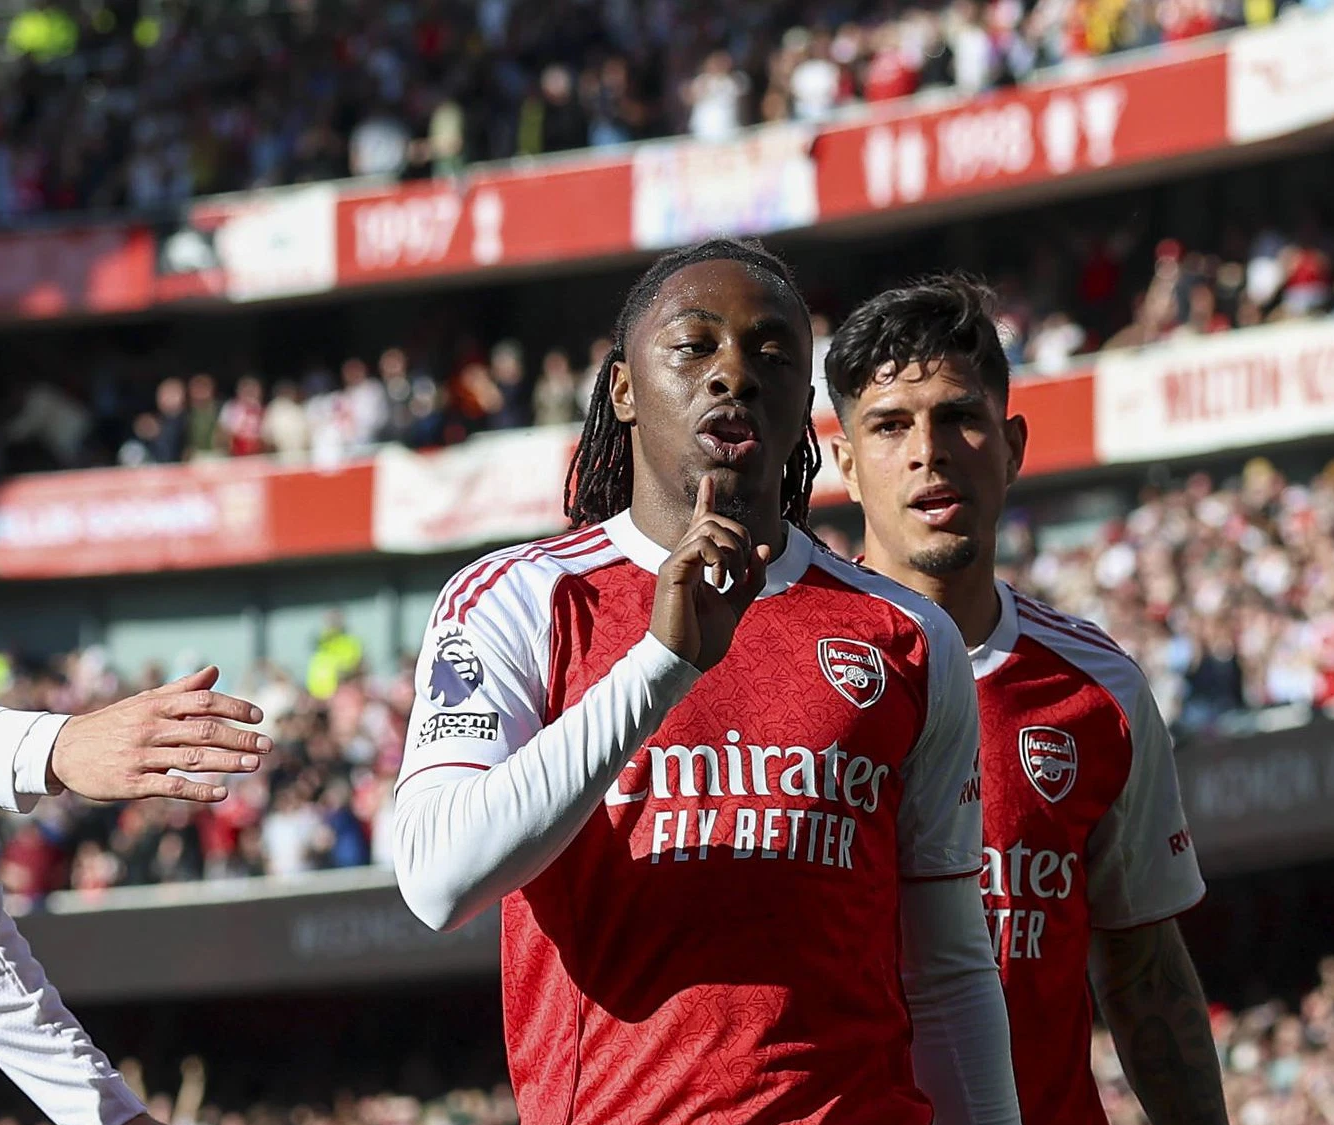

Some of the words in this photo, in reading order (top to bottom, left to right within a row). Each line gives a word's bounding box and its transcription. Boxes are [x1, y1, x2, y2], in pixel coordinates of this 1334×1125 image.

[828, 648, 873, 667] Arsenal
[438, 714, 490, 727] room
[436, 726, 497, 740] racism
[651, 810, 715, 865] FLY
[734, 809, 855, 869] BETTER
